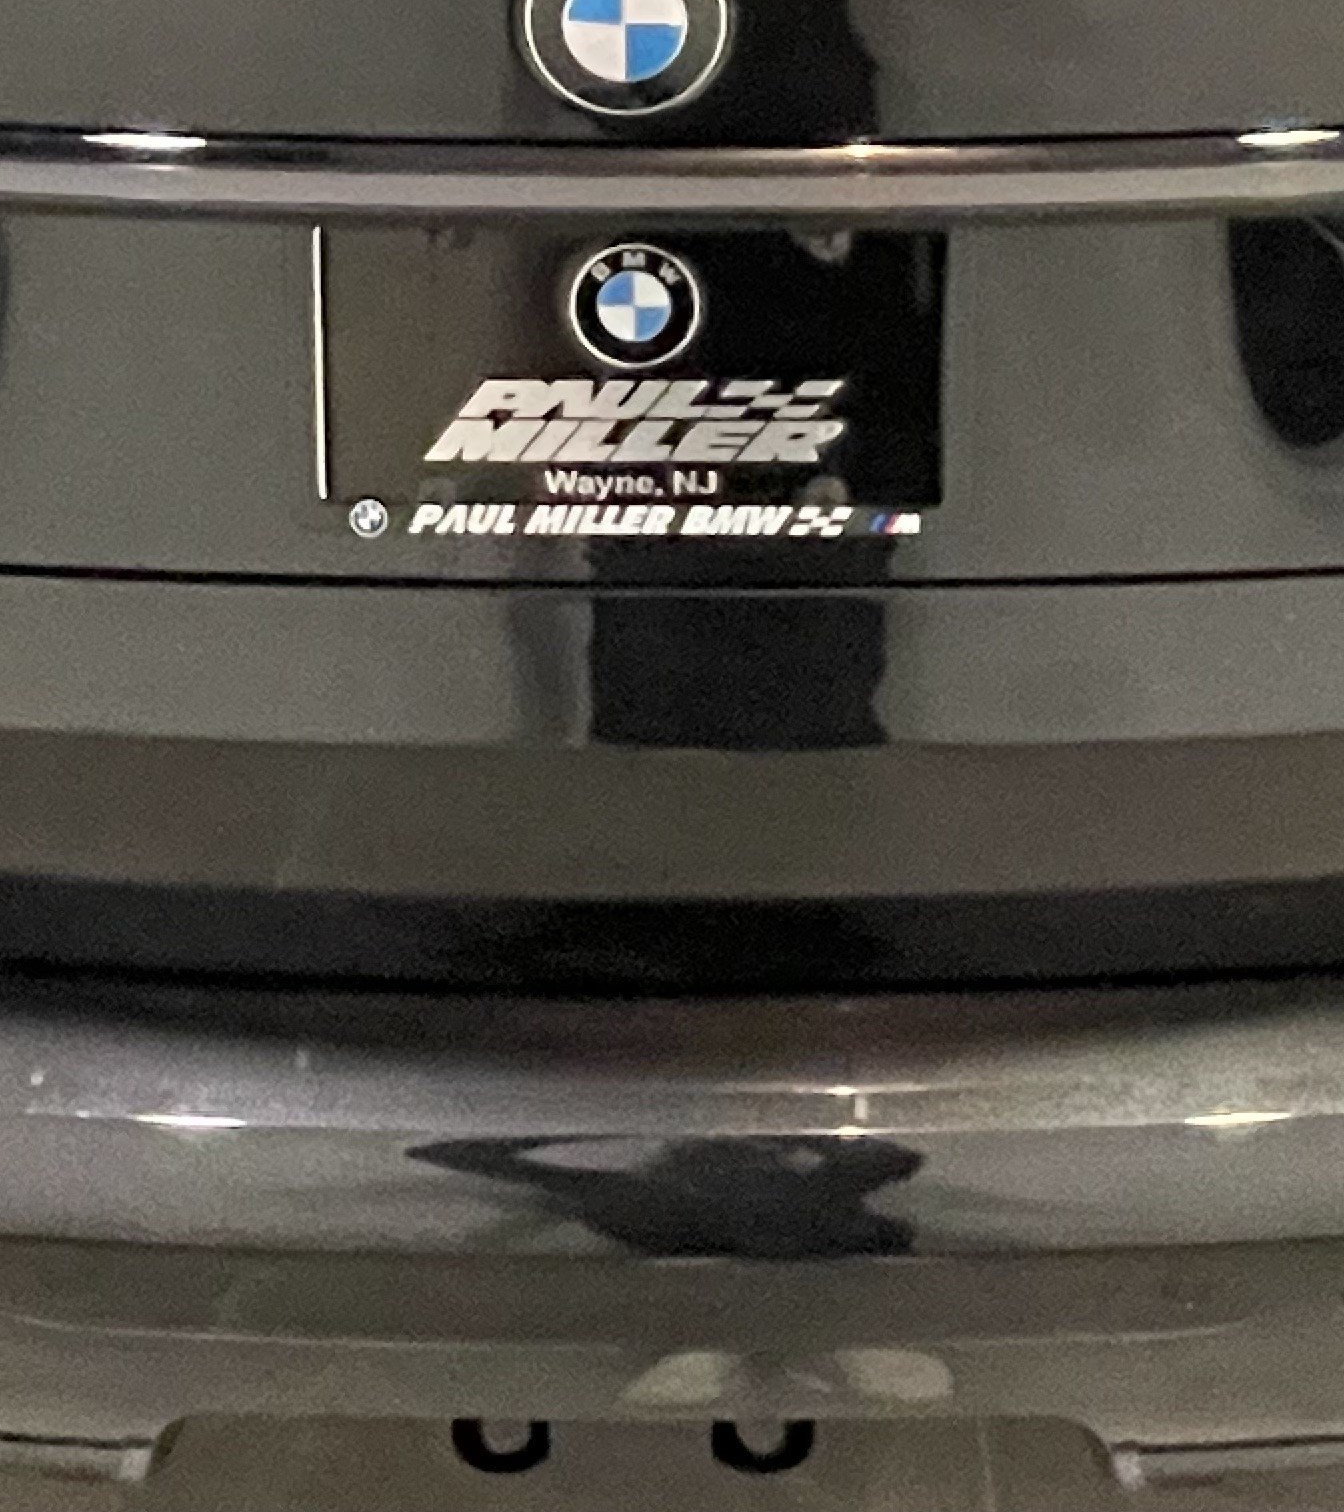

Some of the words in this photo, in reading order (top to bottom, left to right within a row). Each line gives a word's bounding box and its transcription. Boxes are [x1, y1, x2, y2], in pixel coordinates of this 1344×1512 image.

[590, 251, 682, 286] BMW
[457, 379, 709, 419] PAUL
[424, 419, 844, 462] MILLER
[672, 470, 719, 496] NJ
[408, 504, 516, 535] PAUL
[523, 504, 676, 535] MILLER
[679, 504, 794, 536] BMW
